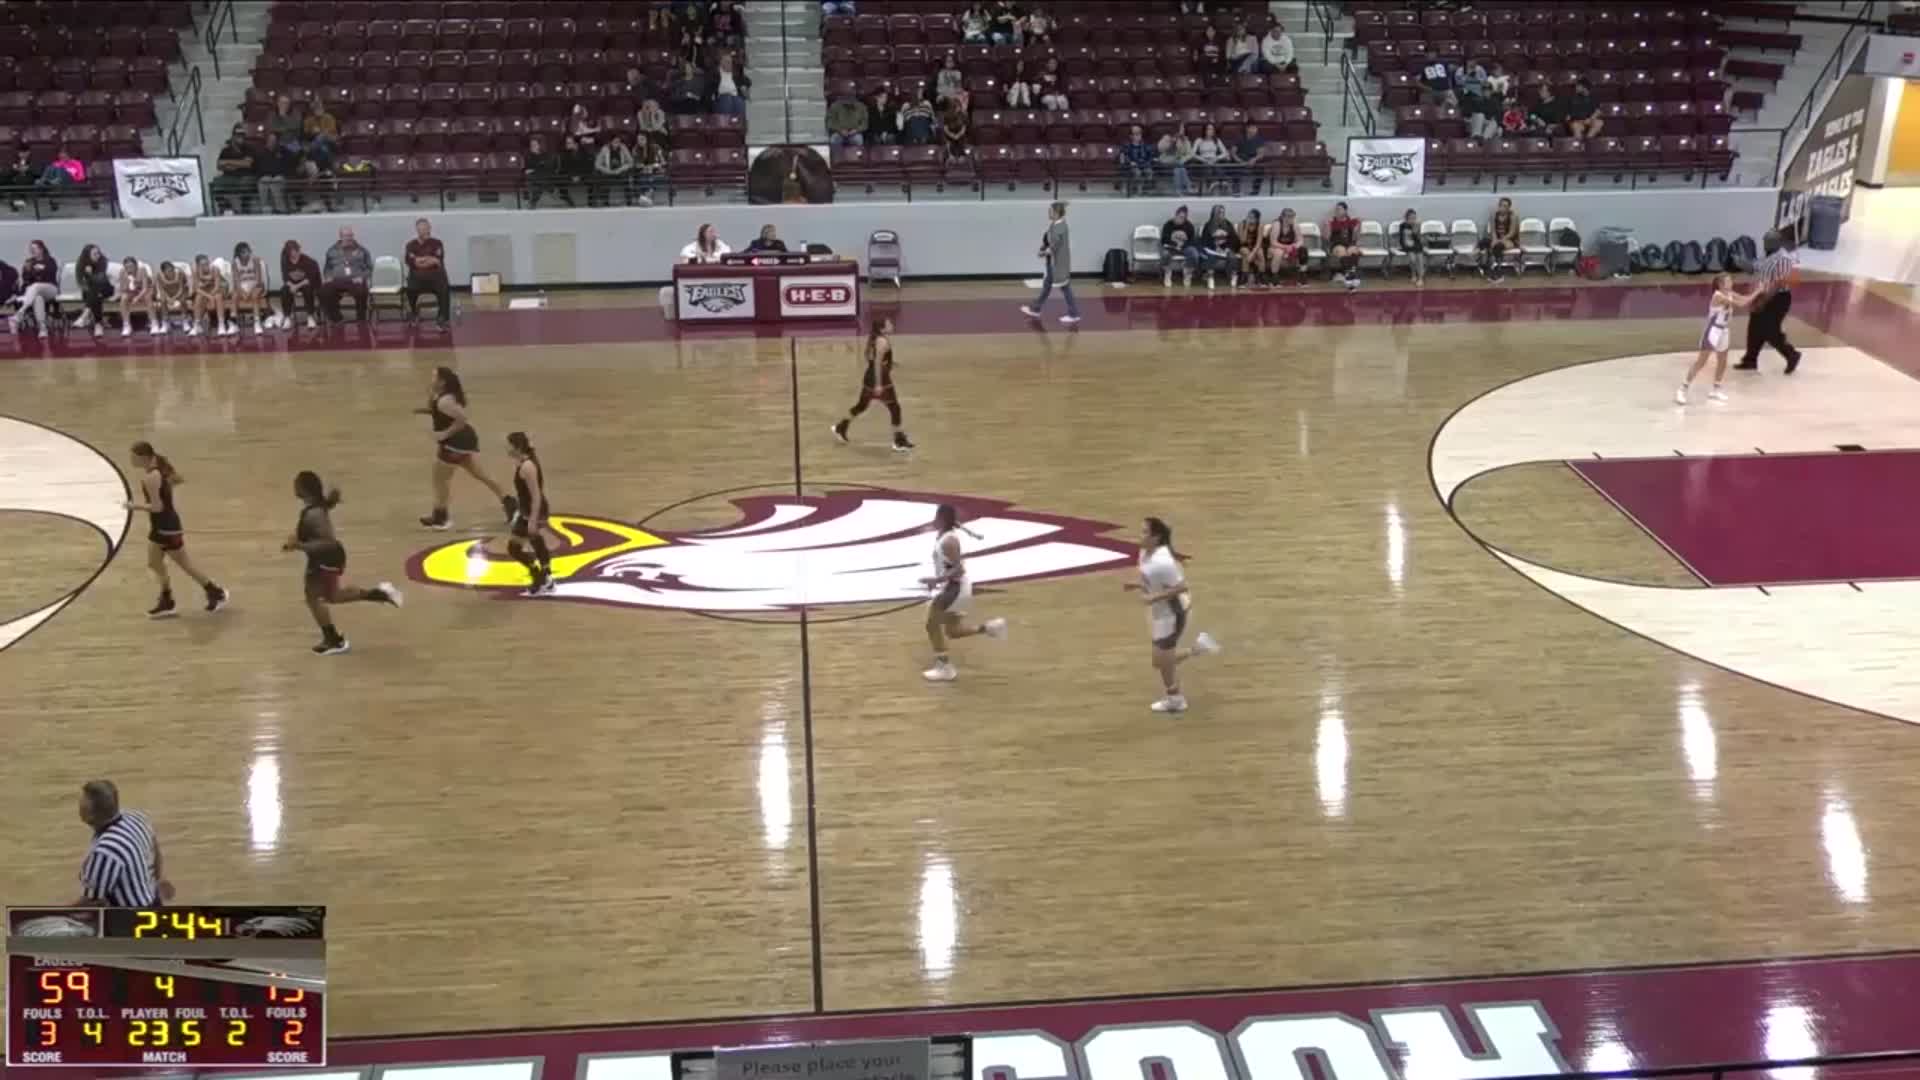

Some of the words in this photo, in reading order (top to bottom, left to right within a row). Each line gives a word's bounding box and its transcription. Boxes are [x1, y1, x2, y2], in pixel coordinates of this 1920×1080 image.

[688, 284, 745, 304] EAGLES
[742, 1059, 800, 1074] Please
[807, 1056, 856, 1076] place
[861, 1055, 902, 1070] your
